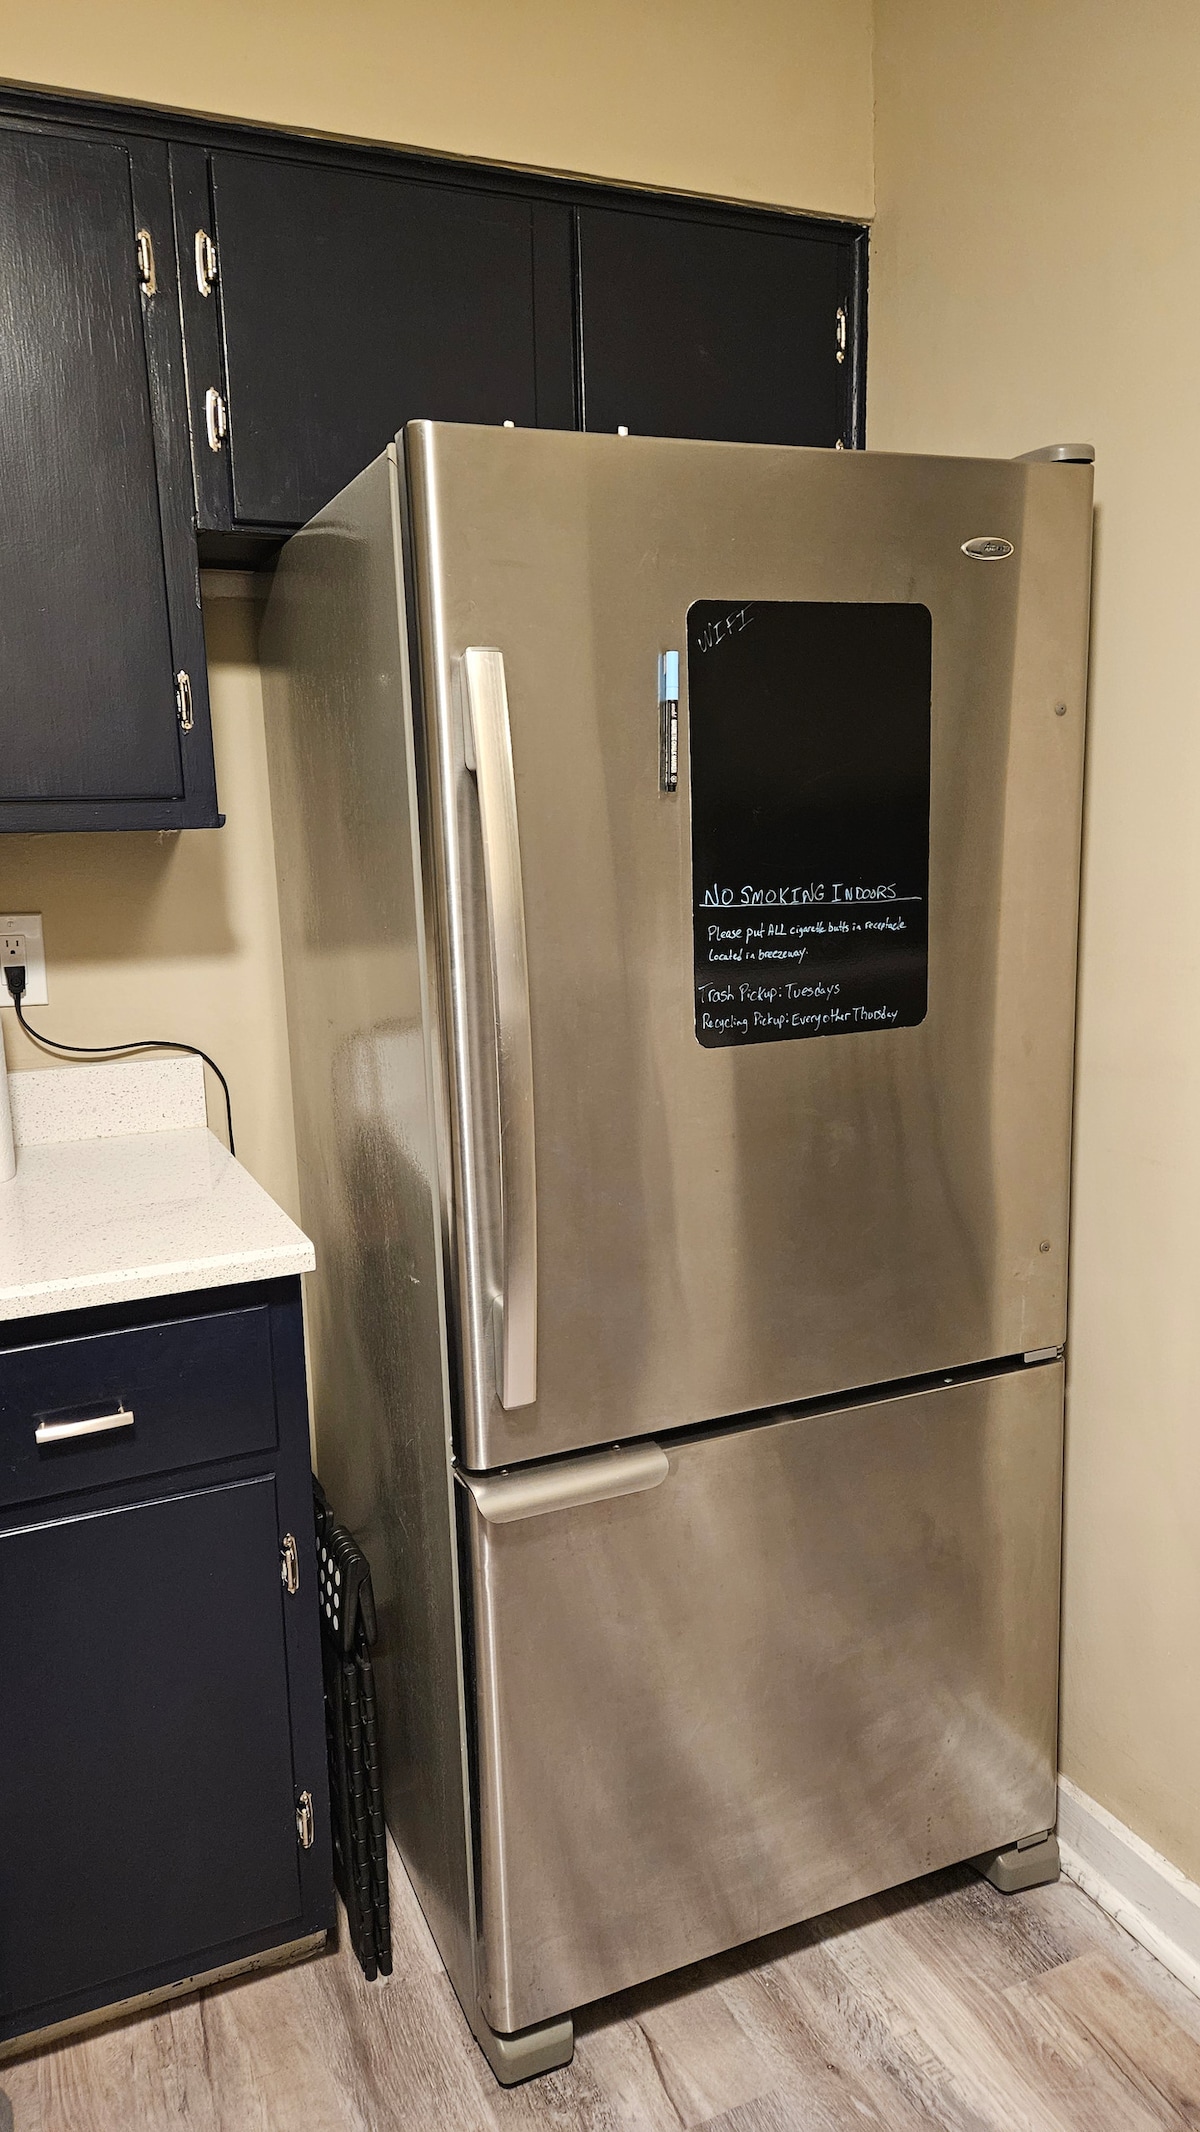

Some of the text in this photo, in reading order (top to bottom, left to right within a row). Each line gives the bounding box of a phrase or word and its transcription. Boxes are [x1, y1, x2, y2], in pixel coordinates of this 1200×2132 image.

[697, 602, 755, 653] WIFI
[704, 883, 734, 906] NO
[740, 882, 825, 905] SMOKING
[708, 917, 907, 944] Please put ALL cigarette butts in receptacle
[746, 950, 755, 960] in
[698, 982, 841, 1004] Trash Pickup: Tuesdays
[702, 1013, 748, 1034] Recycling
[753, 1011, 789, 1030] Pickup:
[852, 1005, 899, 1022] Thursday
